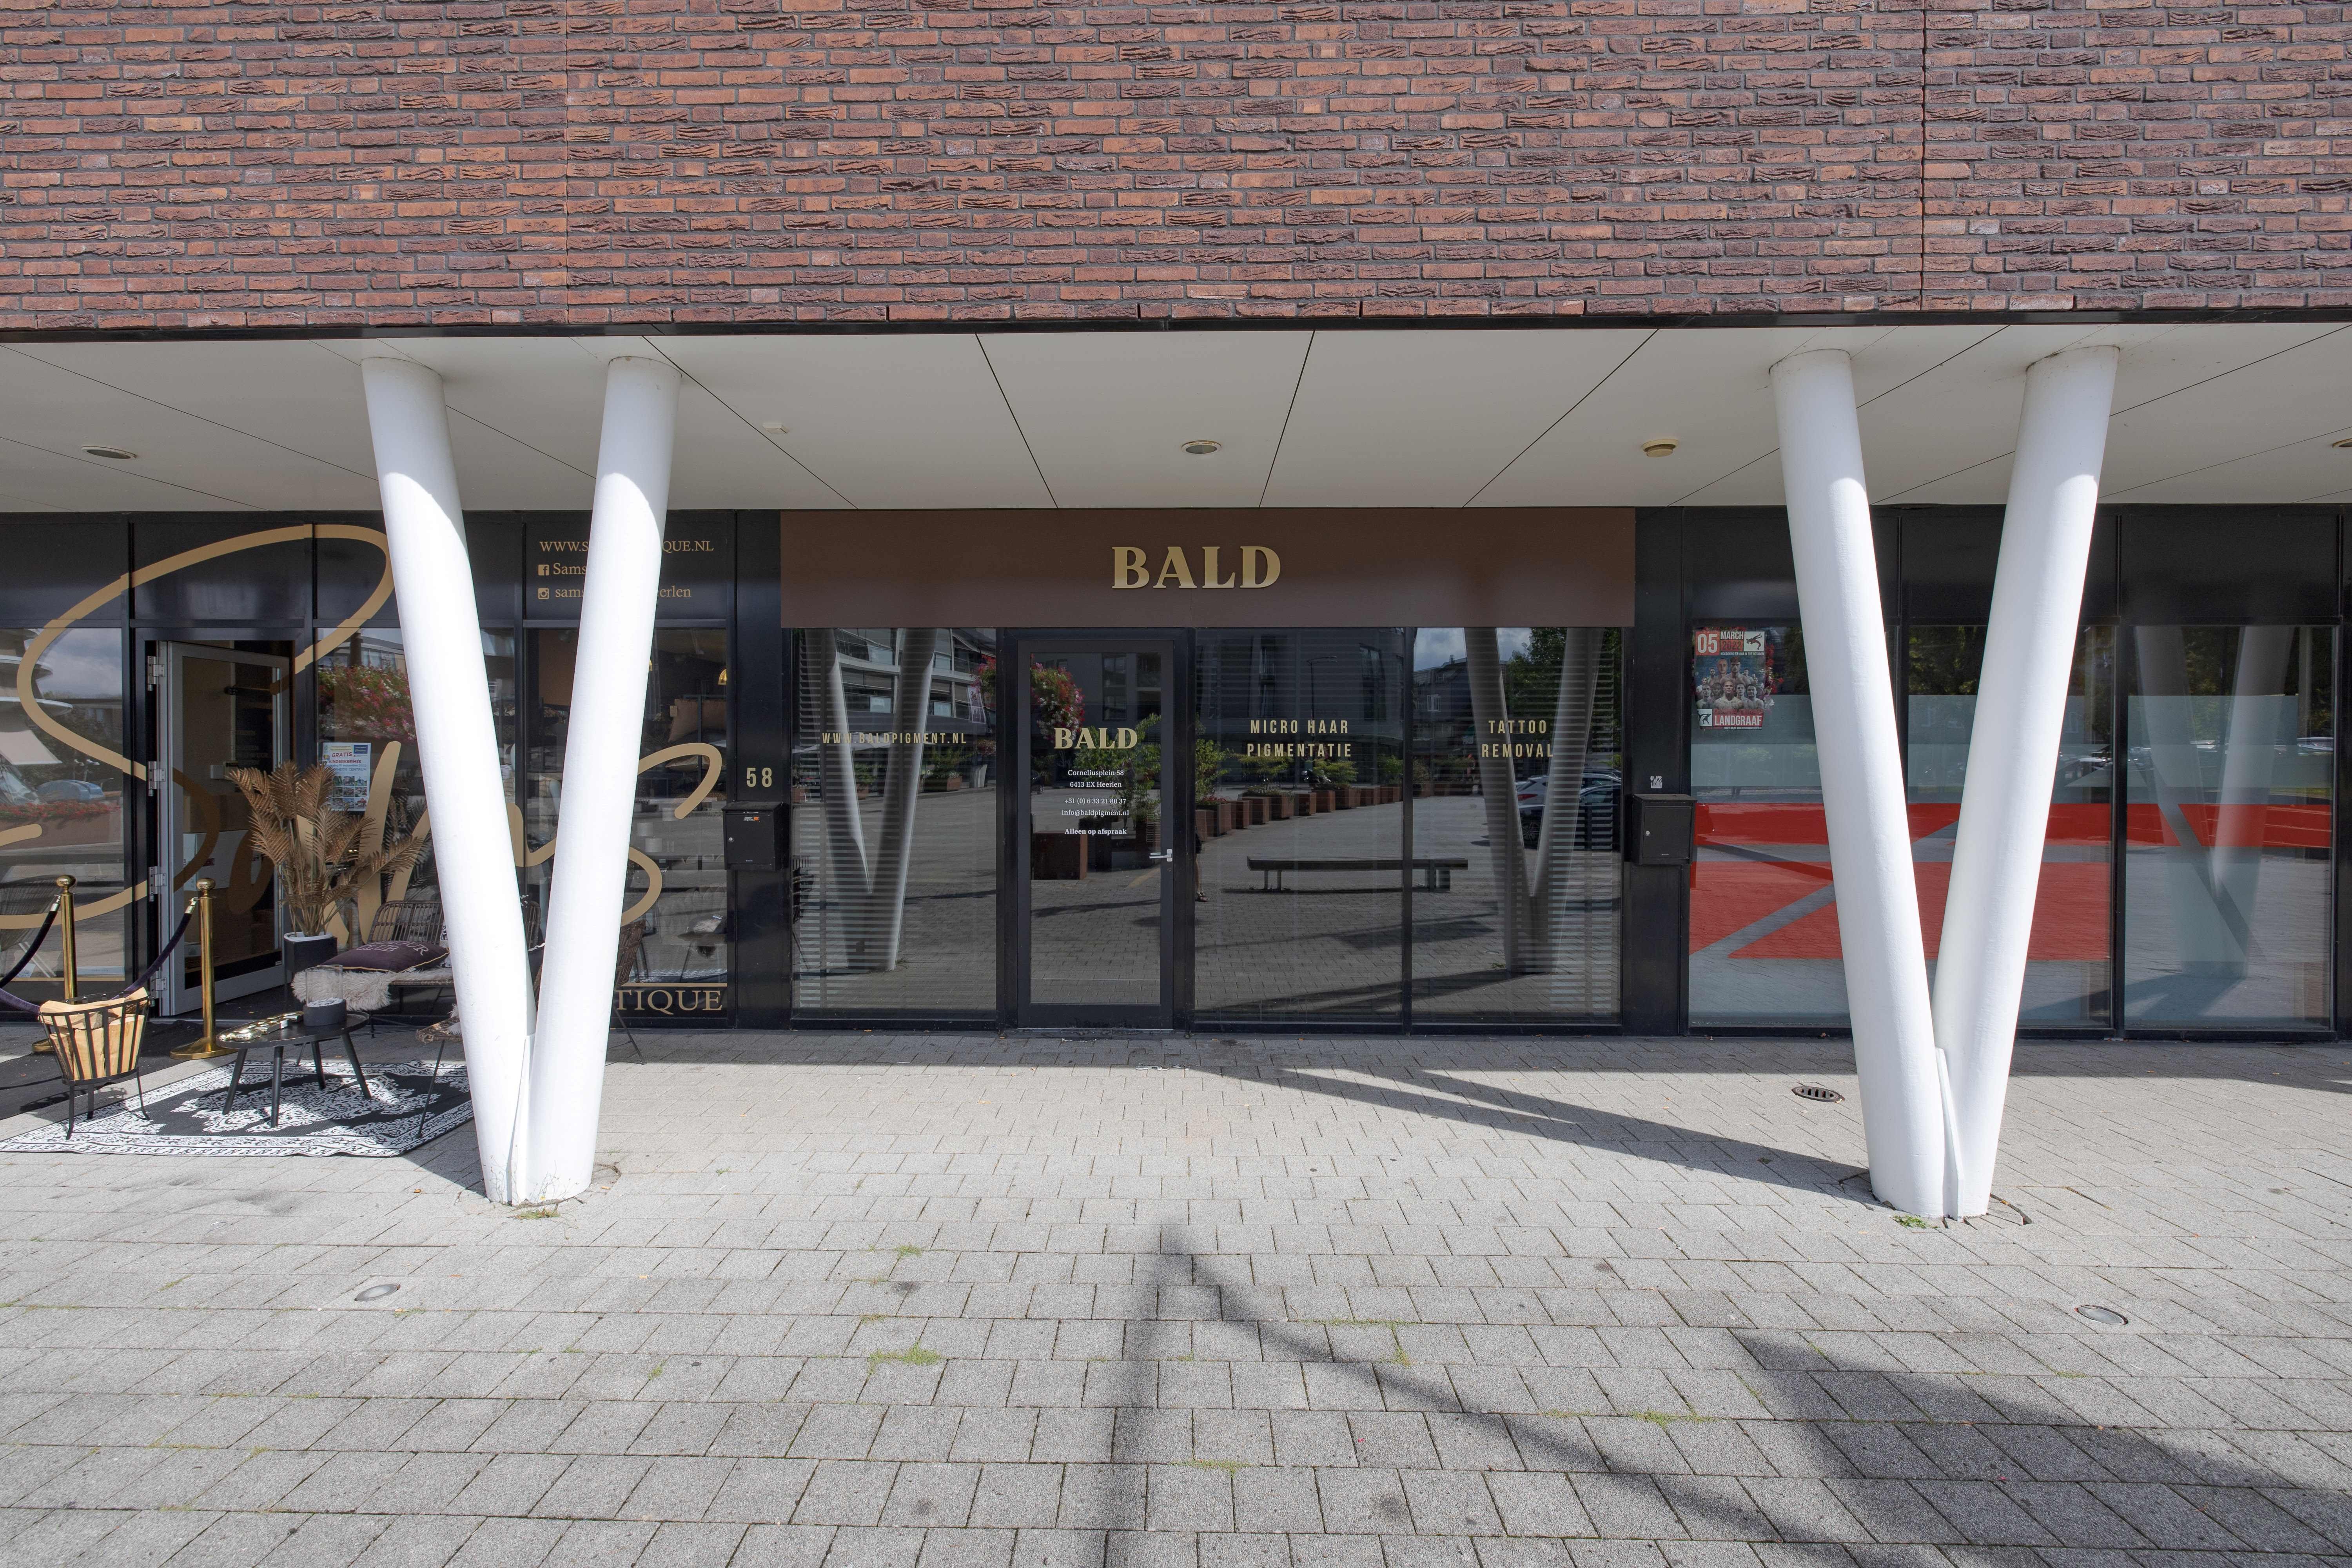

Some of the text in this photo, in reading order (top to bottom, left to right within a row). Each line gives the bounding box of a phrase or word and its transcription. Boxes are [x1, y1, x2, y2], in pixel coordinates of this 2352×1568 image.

[539, 541, 715, 554] WWW.SQUE.NL
[1111, 546, 1283, 589] BALD
[1720, 631, 1744, 640] MARCH
[1697, 633, 1718, 653] 05
[1722, 641, 1742, 650] 2022
[1250, 720, 1349, 734] MICRO HAAR
[1488, 720, 1547, 734] TATTOO
[1714, 715, 1762, 726] LANDGRAAF
[822, 733, 967, 744] WWW.BALDPIGMENT.NL
[1054, 728, 1138, 749] BALD
[1247, 743, 1352, 757] PIGMENTATIE
[1481, 744, 1553, 757] REMOVAL
[746, 767, 772, 788] 58
[615, 990, 723, 1015] TIQUE
